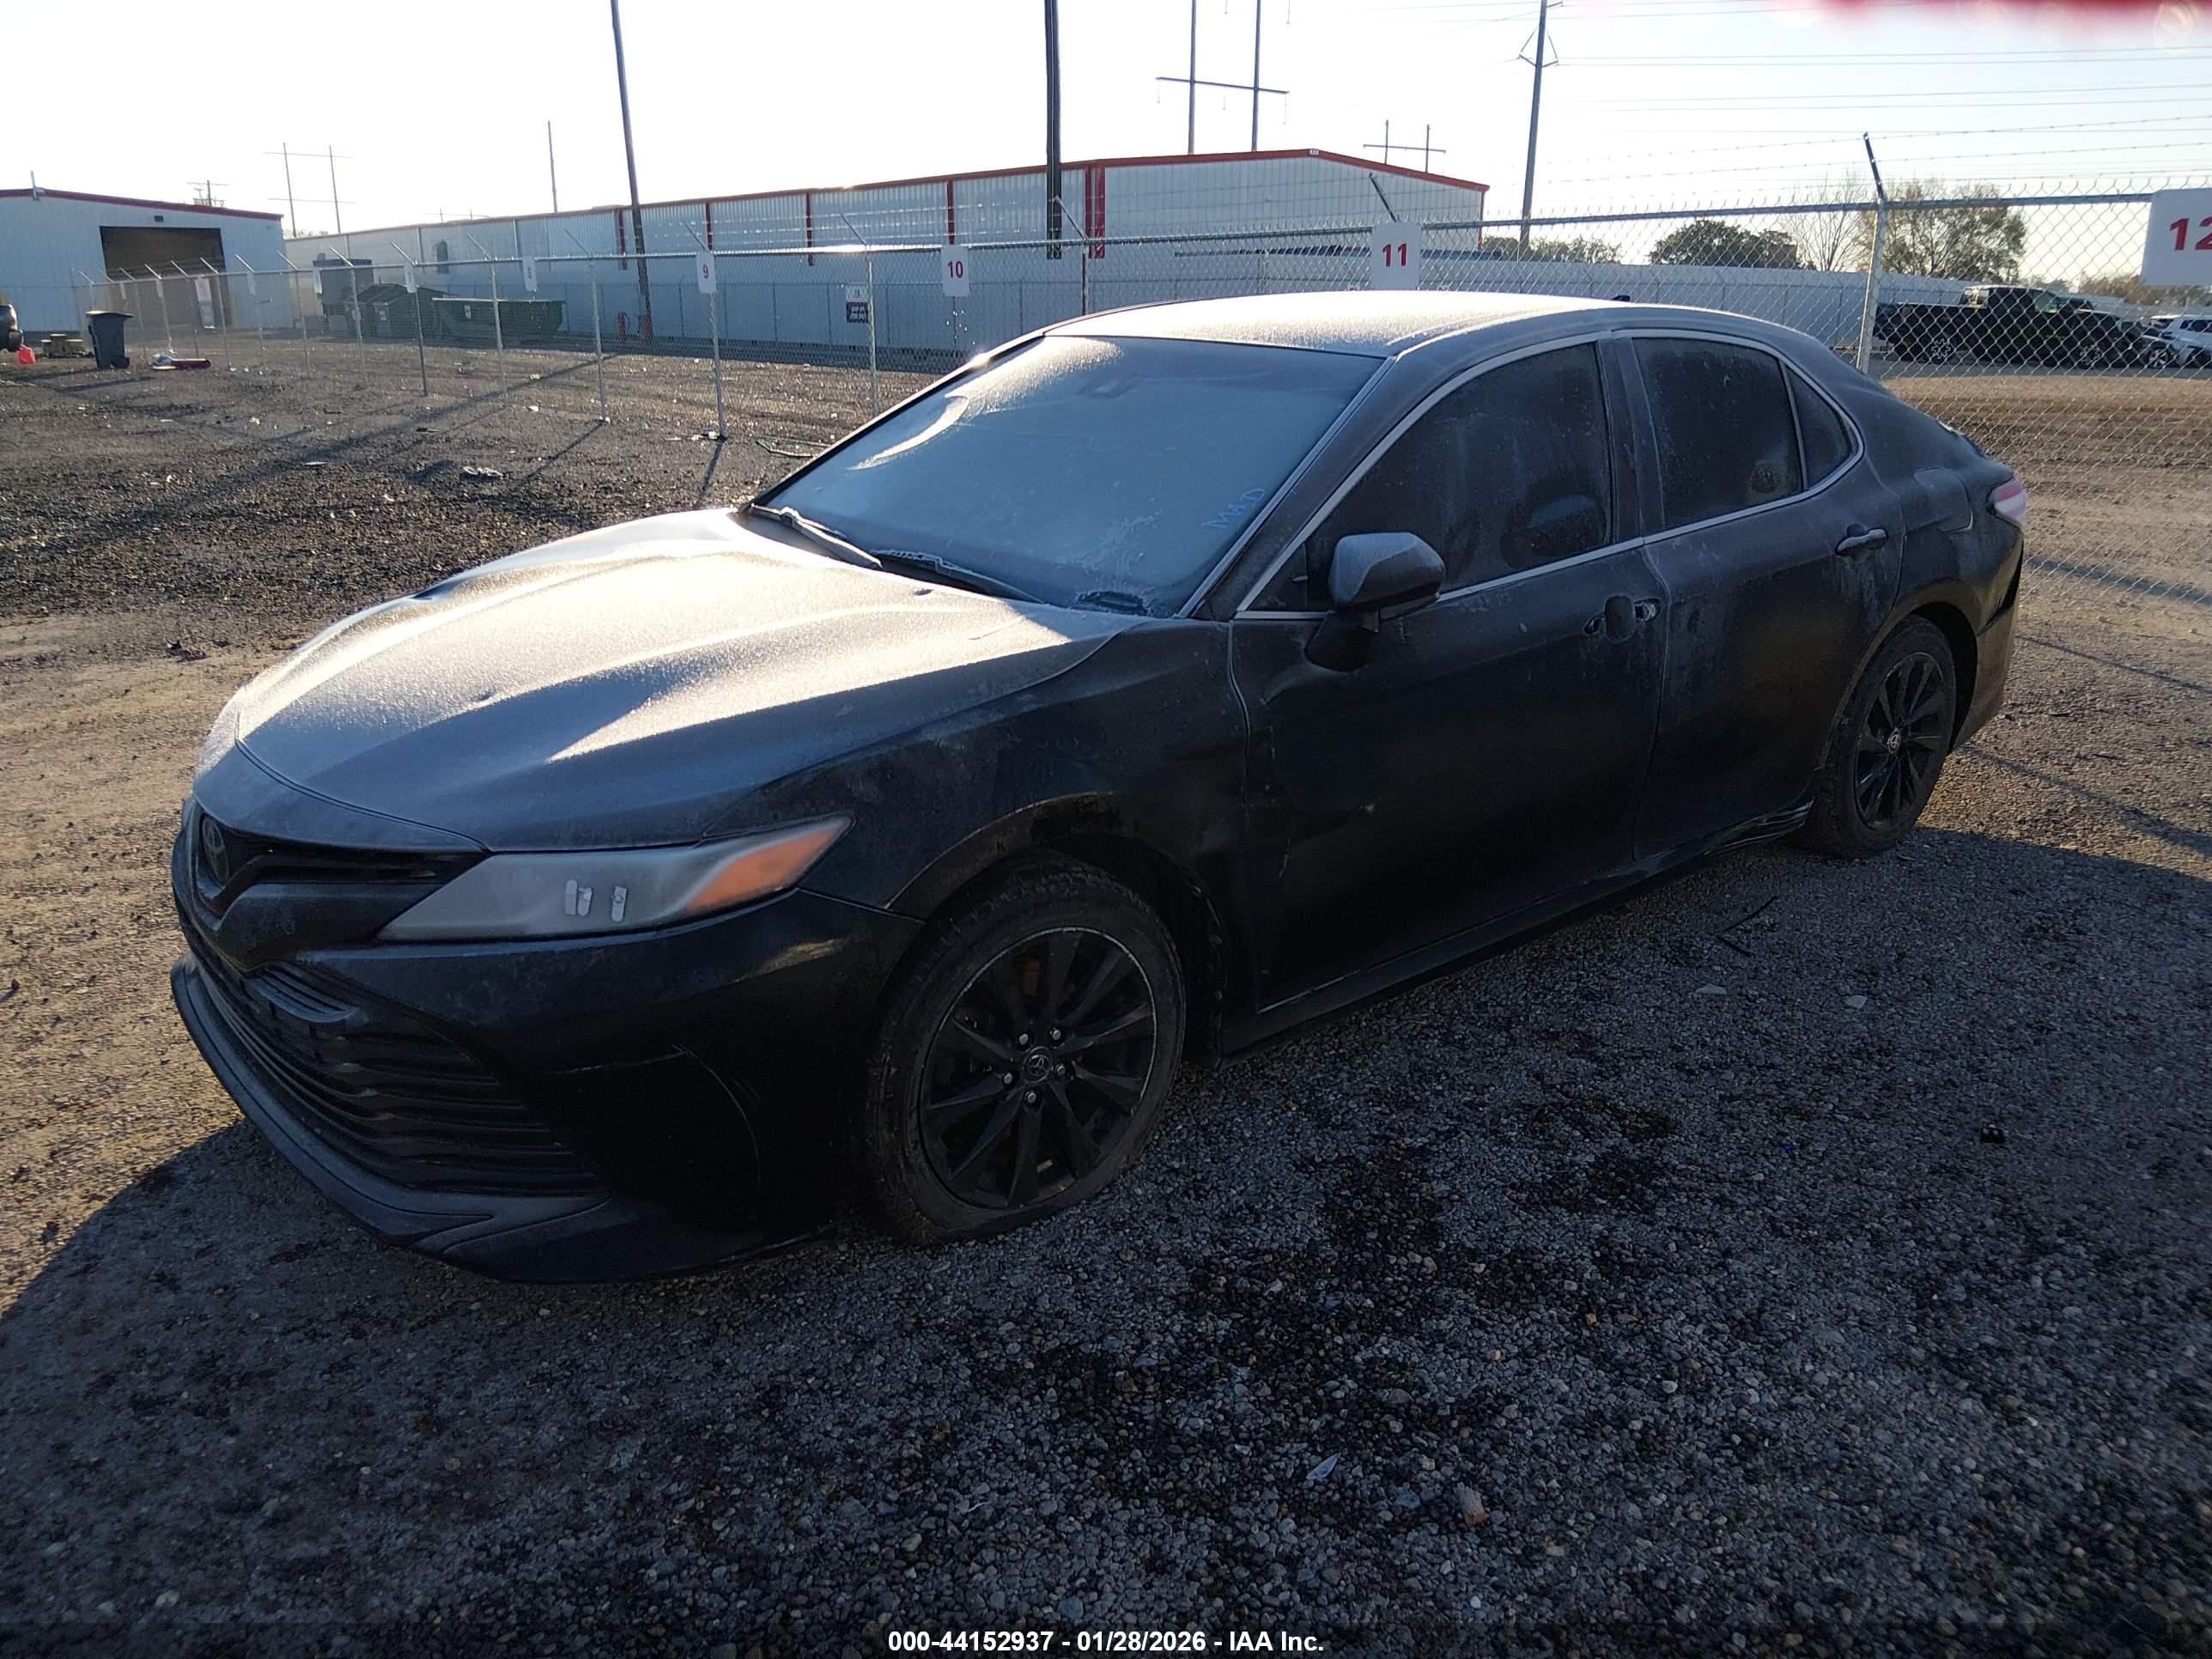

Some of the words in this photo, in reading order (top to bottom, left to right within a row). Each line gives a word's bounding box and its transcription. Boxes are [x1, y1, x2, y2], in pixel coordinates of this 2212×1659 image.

[2169, 216, 2212, 251] 12
[1382, 243, 1407, 267] 11
[702, 264, 709, 279] 9
[948, 260, 963, 279] 10
